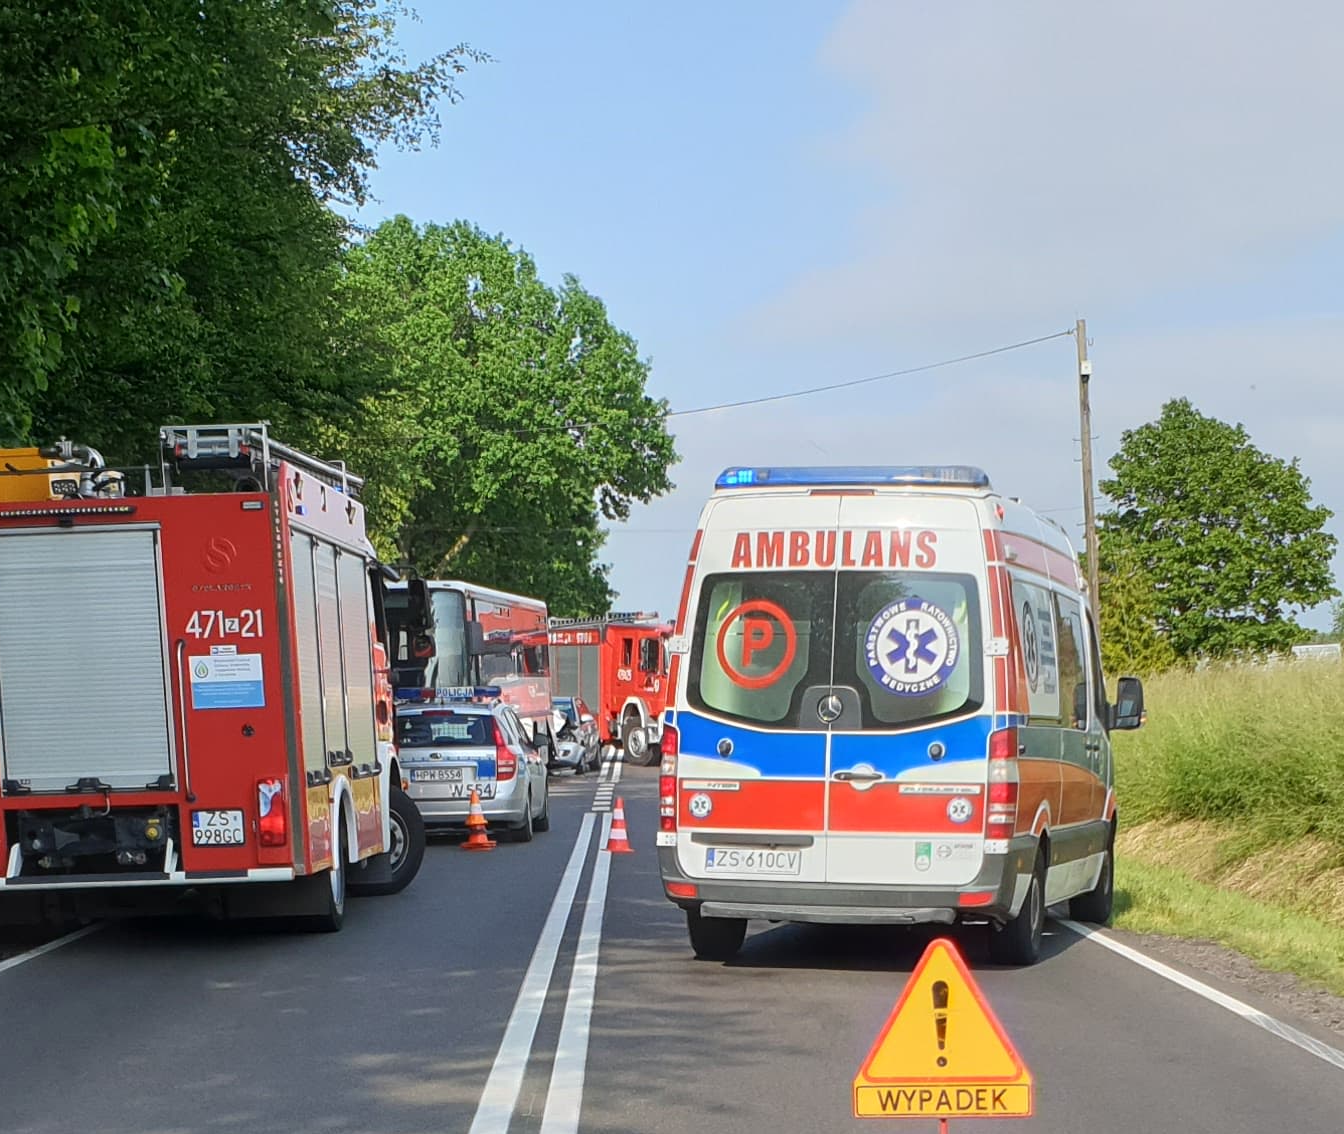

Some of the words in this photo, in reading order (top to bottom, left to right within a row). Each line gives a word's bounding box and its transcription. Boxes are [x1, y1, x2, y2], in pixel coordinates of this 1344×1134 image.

[731, 530, 938, 569] AMBULANS
[741, 617, 774, 668] P
[920, 602, 958, 667] RATOWNICTWO
[436, 687, 474, 697] POLICJA
[881, 674, 942, 693] MEDYCZNE
[415, 769, 436, 779] HPW
[206, 811, 230, 827] ZS
[195, 828, 242, 845] 998GC
[716, 851, 740, 867] ZS
[745, 851, 797, 869] 610CV
[877, 1088, 1008, 1112] WYPADEK
